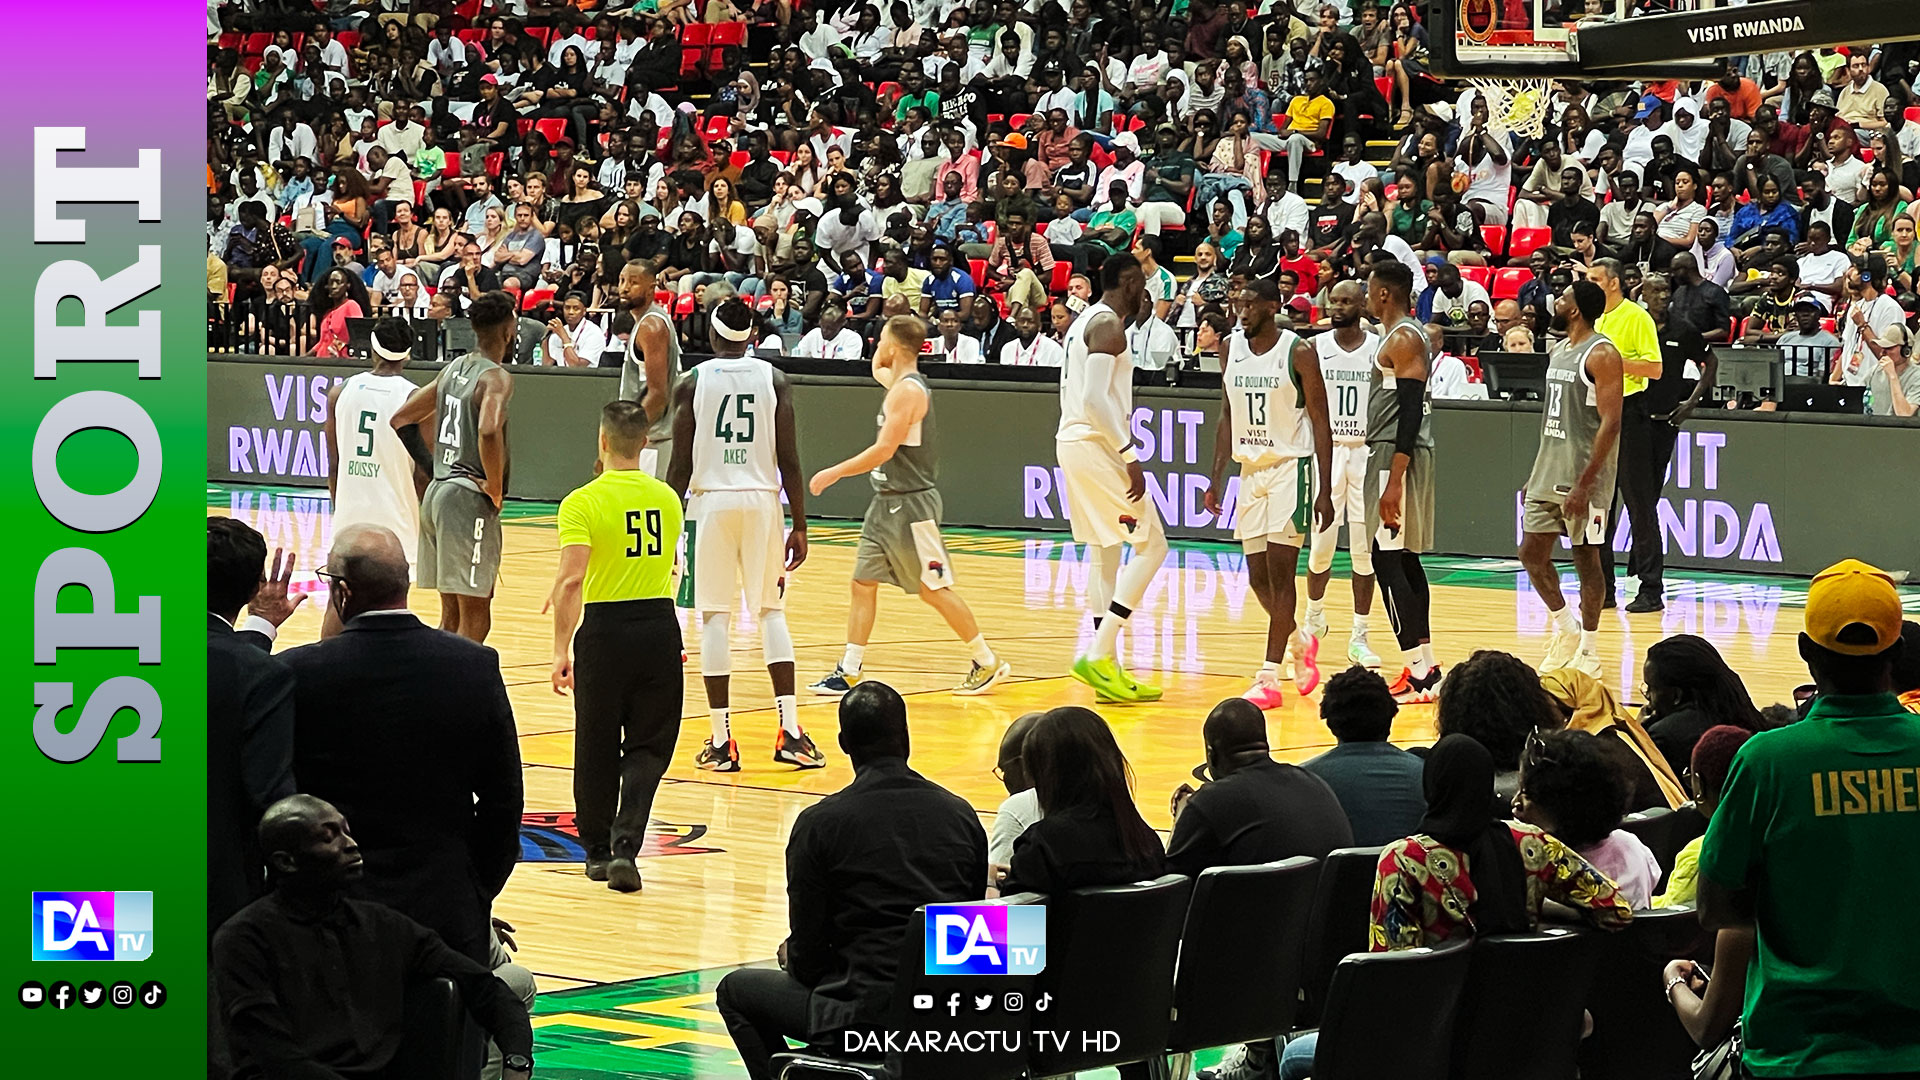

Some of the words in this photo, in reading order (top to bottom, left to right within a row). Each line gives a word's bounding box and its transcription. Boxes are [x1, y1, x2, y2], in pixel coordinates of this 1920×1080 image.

[1687, 24, 1728, 43] VISIT
[1732, 15, 1805, 38] RWANDA
[263, 374, 343, 424] VIS
[1244, 392, 1266, 426] 13
[1336, 385, 1358, 416] 10
[1548, 382, 1563, 418] 13
[356, 410, 377, 457] 5
[439, 393, 462, 449] 23
[715, 394, 755, 443] 45
[1130, 406, 1205, 464] SIT
[1247, 429, 1267, 438] VISIT
[1331, 427, 1367, 437] WANDA
[1334, 420, 1358, 428] VISIT
[229, 426, 329, 478] RWA
[723, 448, 747, 465] AKEC
[1240, 437, 1275, 447] RWANDA
[347, 460, 381, 478] BOISSY
[626, 510, 662, 558] 59
[468, 517, 485, 588] BAL
[1812, 767, 1920, 816] USHE
